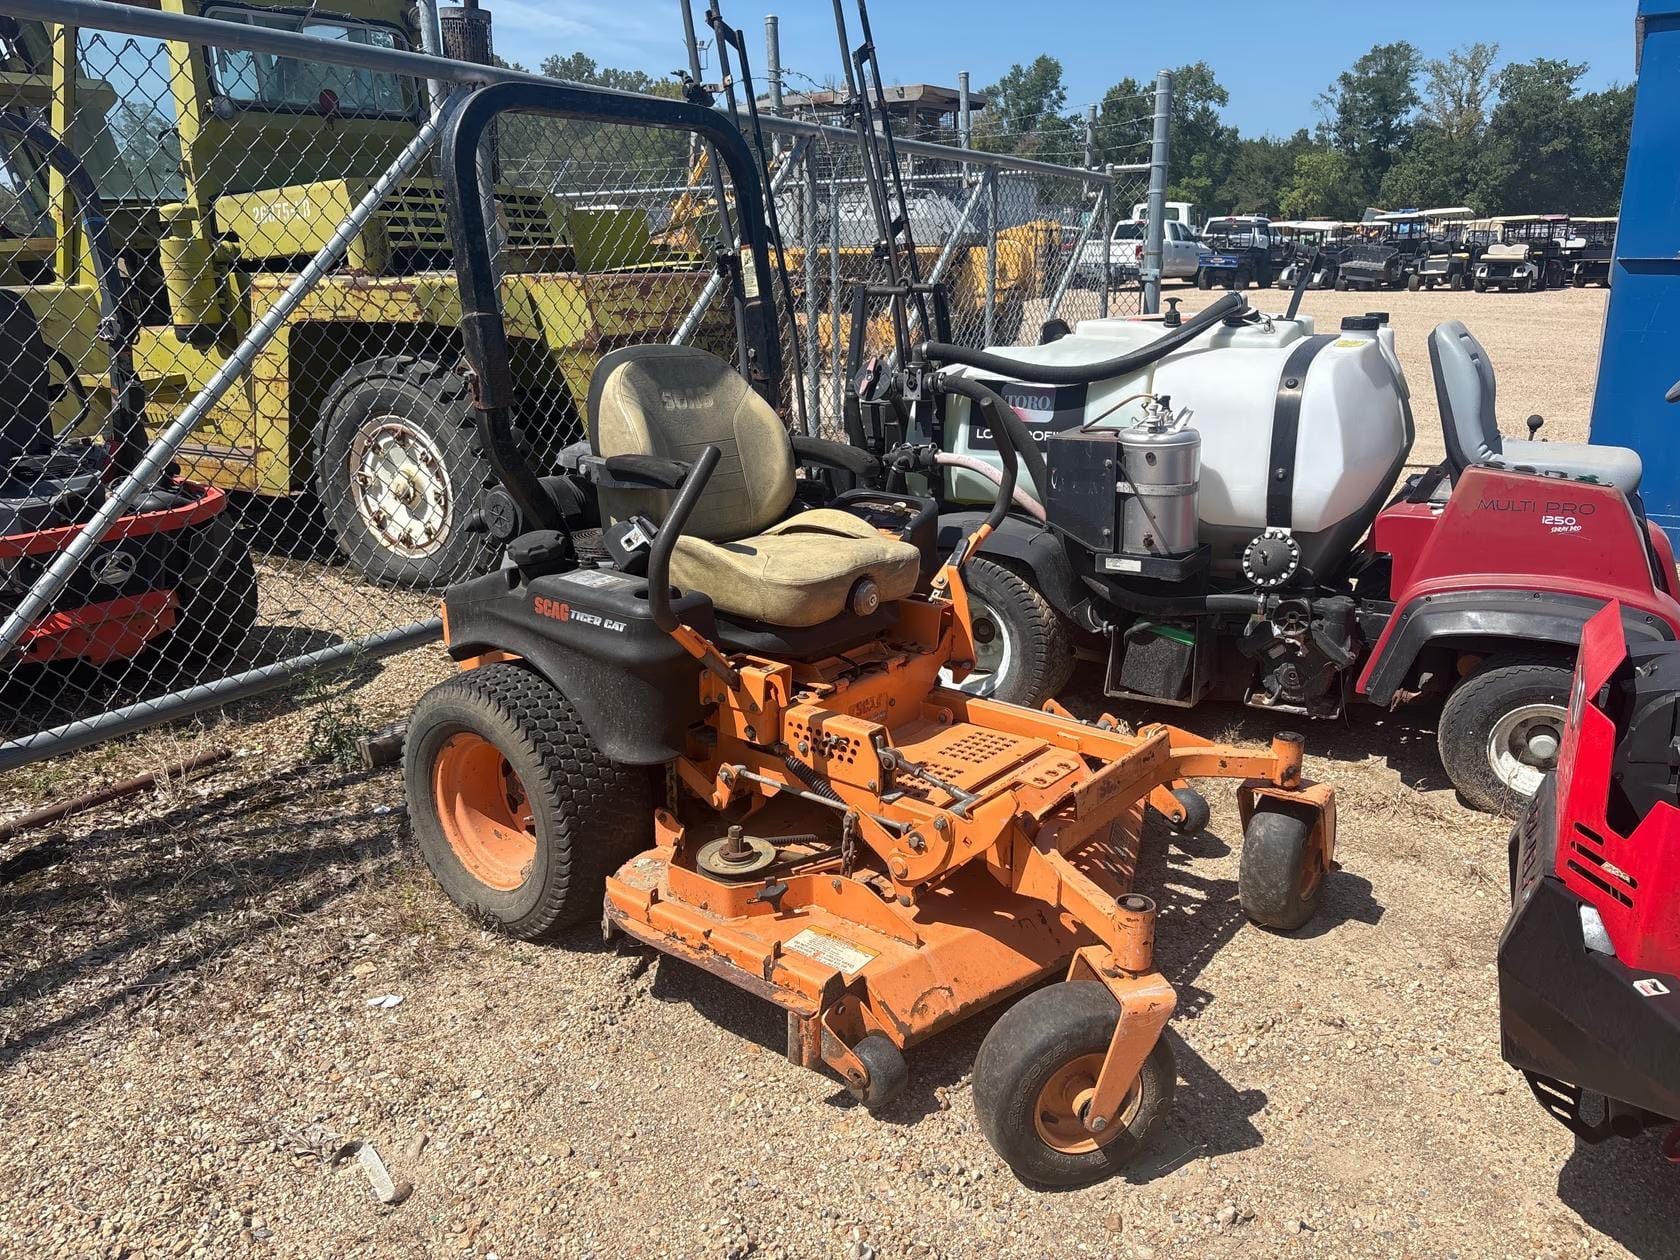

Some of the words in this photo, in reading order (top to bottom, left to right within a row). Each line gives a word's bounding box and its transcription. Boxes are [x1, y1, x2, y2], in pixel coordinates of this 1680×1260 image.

[1005, 395, 1051, 411] TORO
[1478, 499, 1536, 512] MULTI
[1545, 501, 1596, 516] PRO
[1541, 515, 1576, 526] 1250
[534, 596, 570, 622] SCAG
[570, 609, 602, 627] TIGER
[603, 618, 627, 633] CAT
